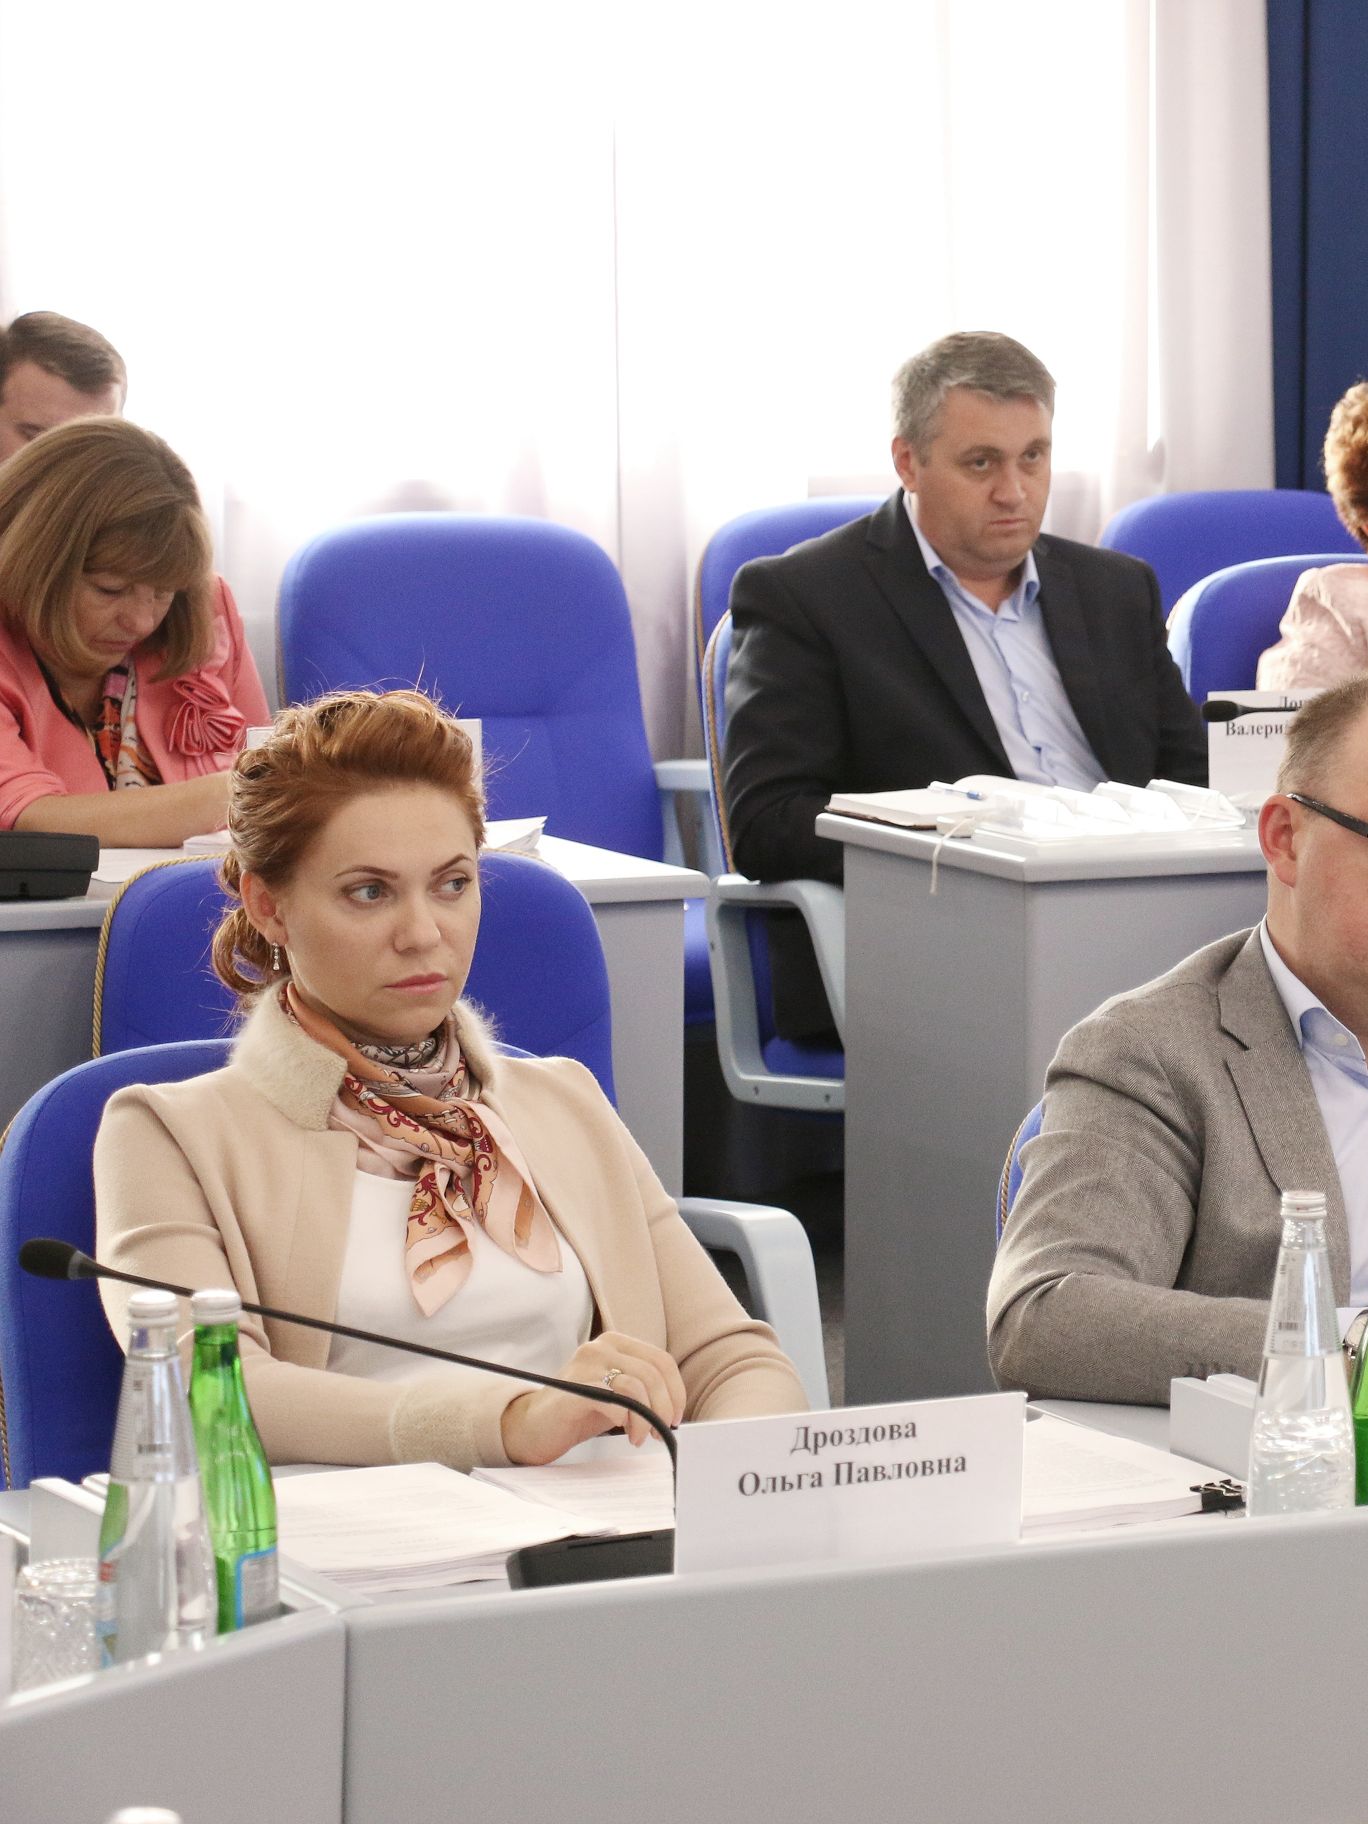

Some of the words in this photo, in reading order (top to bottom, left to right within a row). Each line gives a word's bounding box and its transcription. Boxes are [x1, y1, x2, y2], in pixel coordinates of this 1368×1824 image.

[1225, 719, 1290, 739] Валери
[789, 1419, 919, 1456] Дроздова
[737, 1469, 825, 1498] Ольга
[833, 1453, 968, 1487] Павловна
